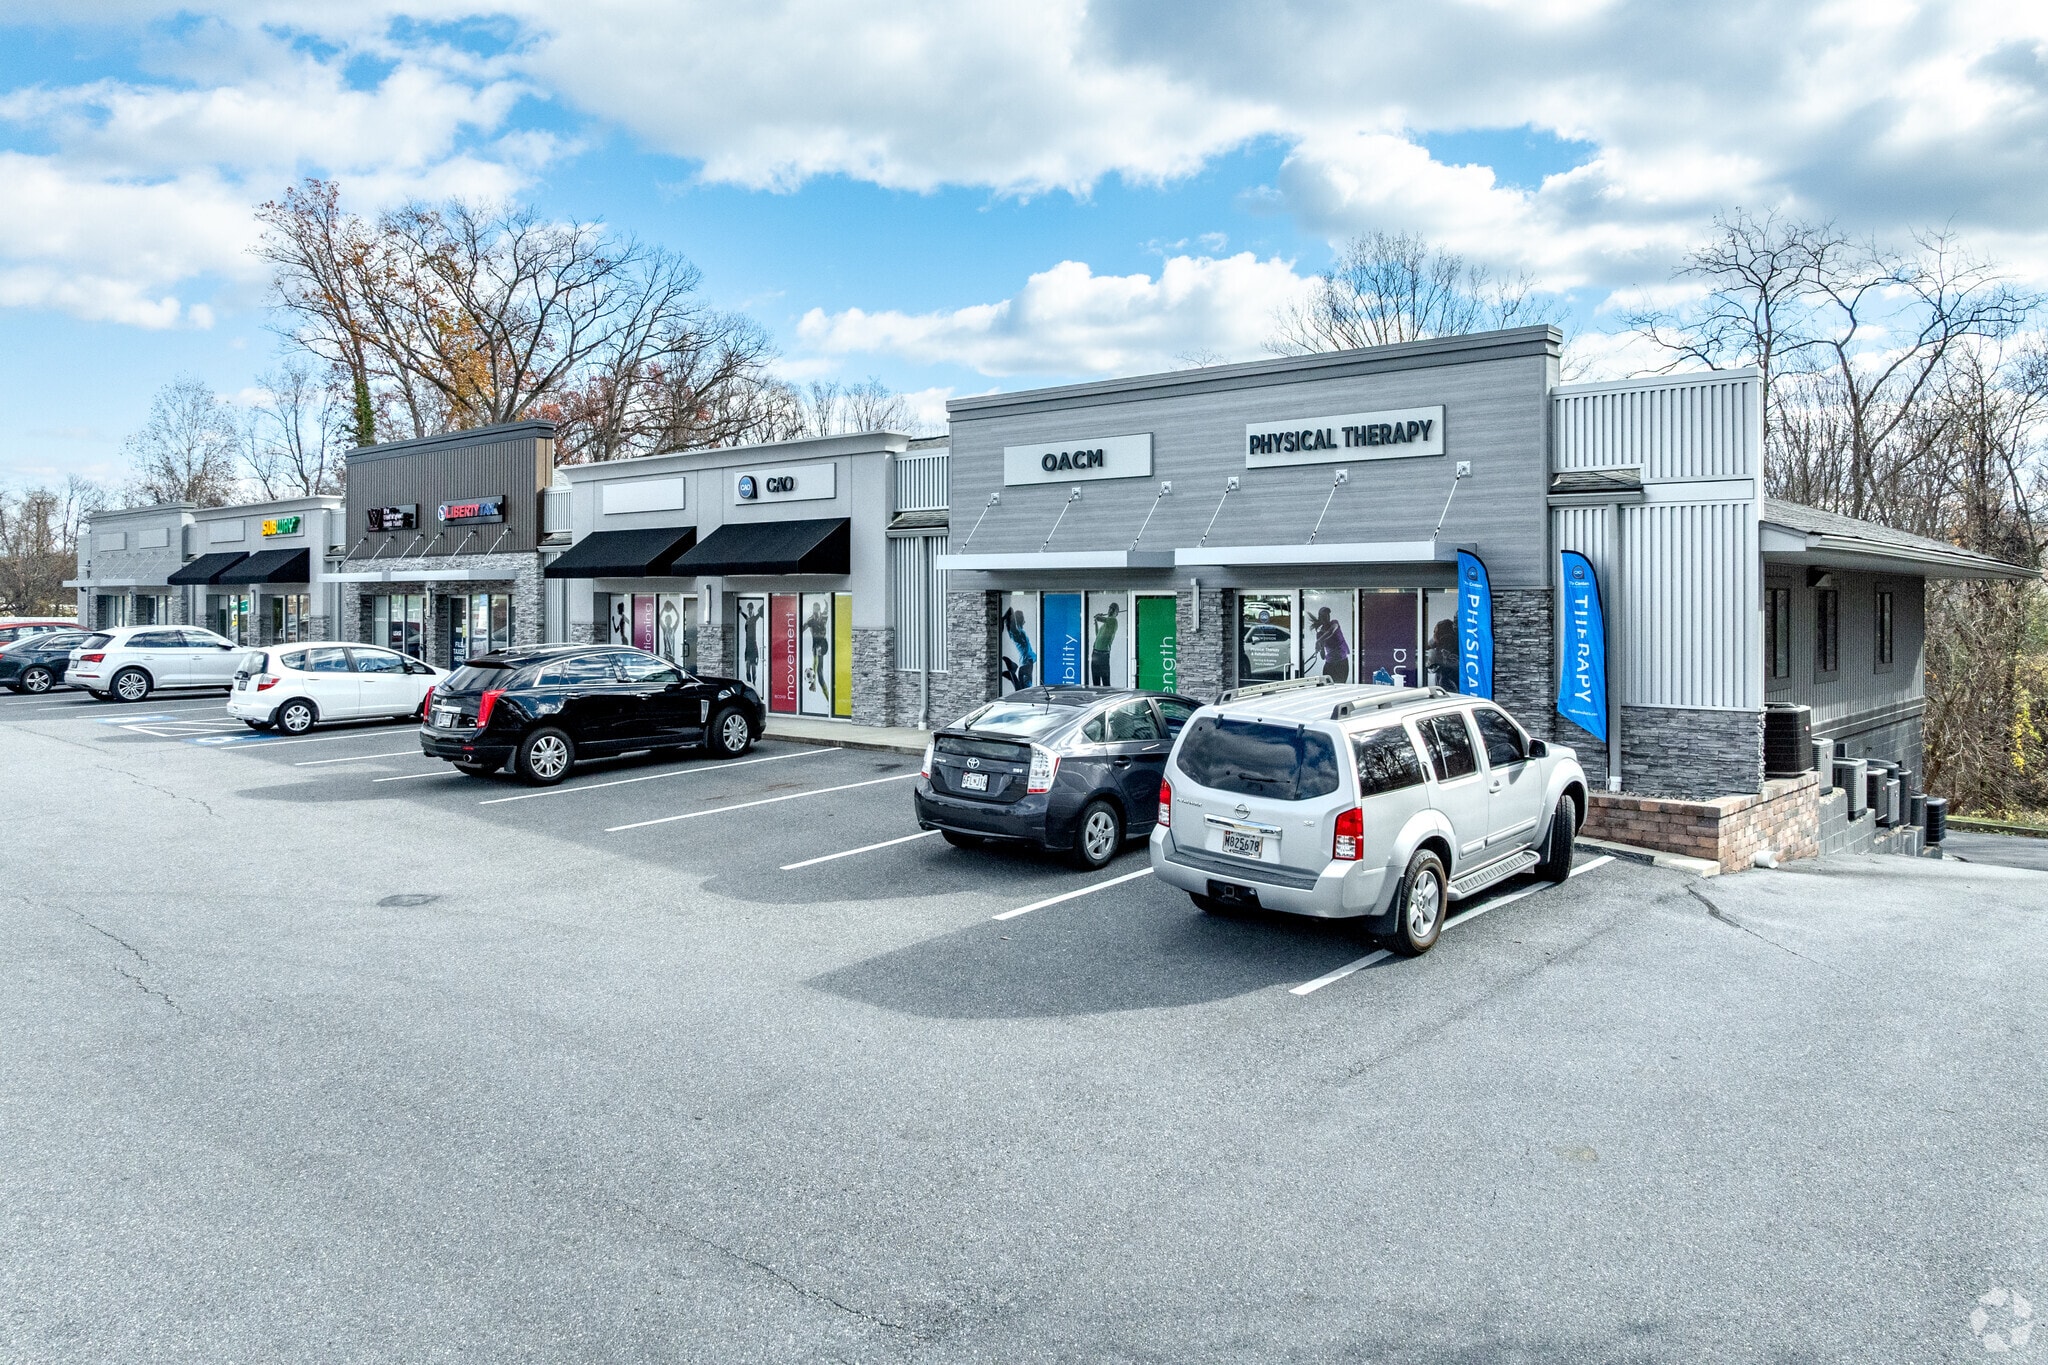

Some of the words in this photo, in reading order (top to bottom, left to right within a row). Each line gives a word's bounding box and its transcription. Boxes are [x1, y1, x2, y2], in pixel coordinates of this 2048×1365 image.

[1249, 428, 1338, 455] PHYSICAL
[1341, 419, 1433, 448] THERAPY
[1041, 448, 1104, 472] OACM
[766, 476, 794, 492] CAO
[446, 504, 480, 519] LIBERTY
[480, 502, 495, 516] TAX
[262, 516, 300, 536] SUBWAY
[785, 612, 795, 700] movement
[1574, 595, 1592, 702] THERAPY
[1225, 835, 1260, 852] M825678
